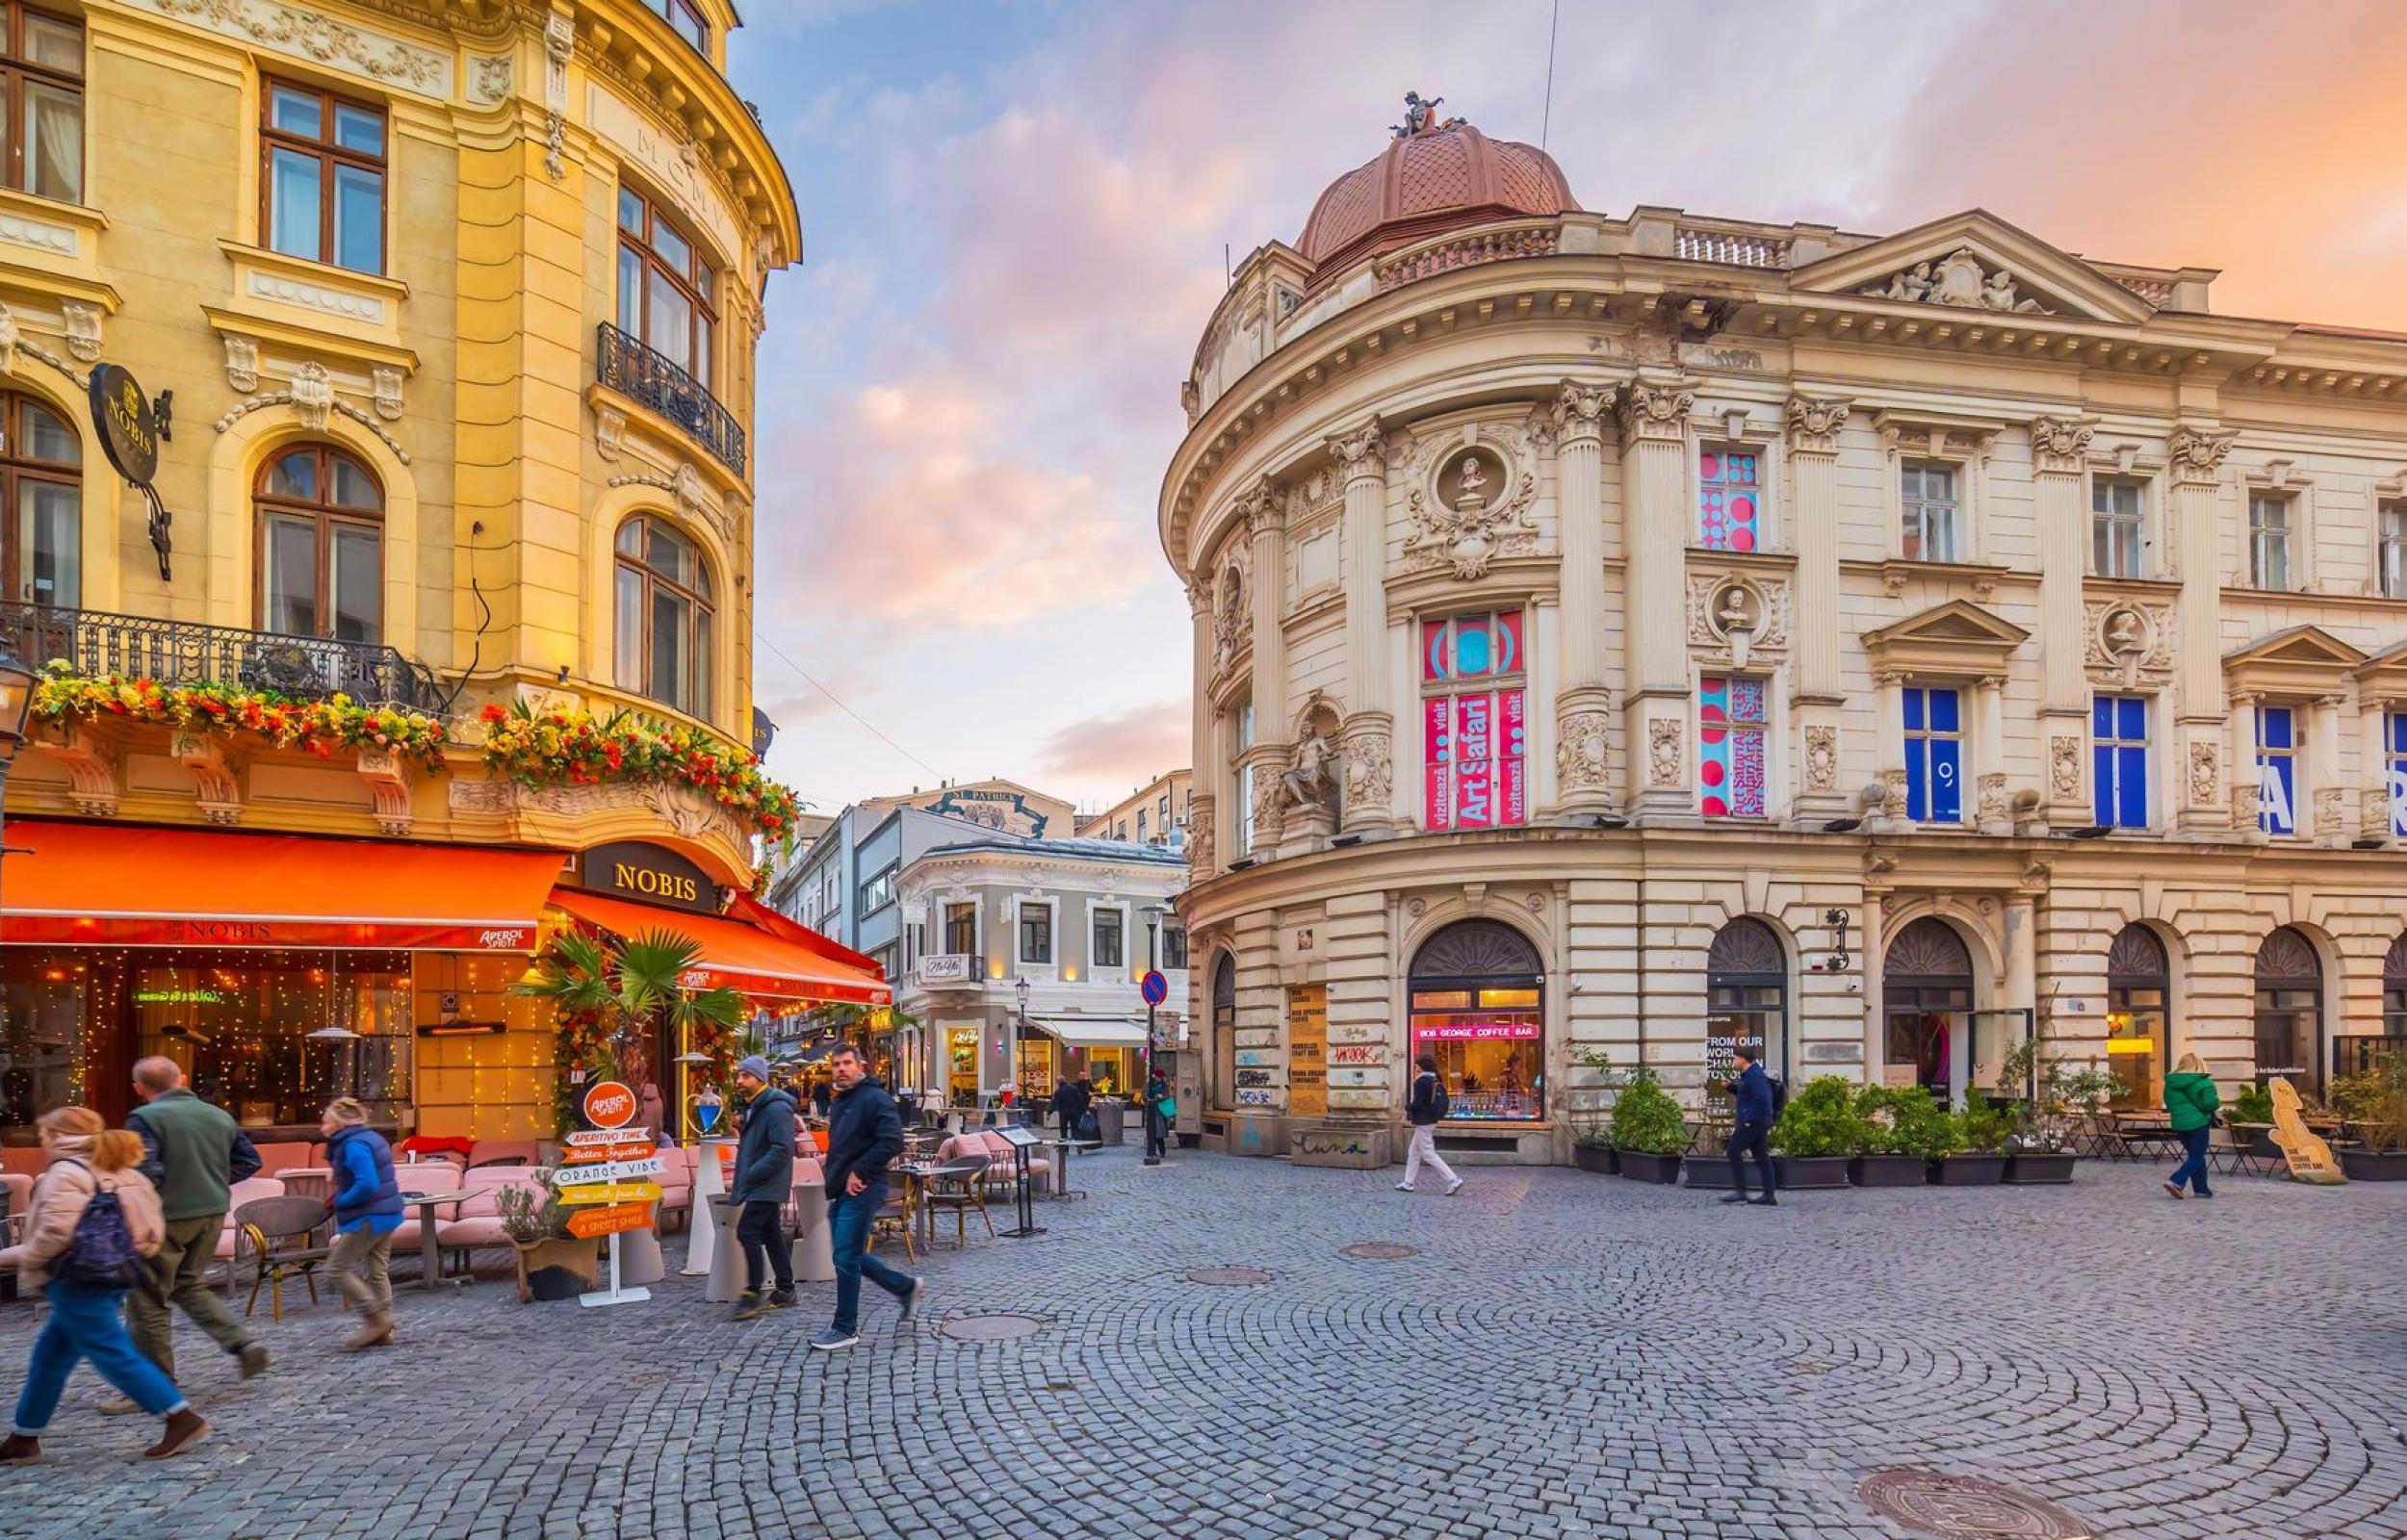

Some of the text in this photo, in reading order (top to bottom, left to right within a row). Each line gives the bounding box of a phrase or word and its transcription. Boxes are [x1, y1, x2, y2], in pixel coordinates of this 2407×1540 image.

[109, 395, 152, 456] NOBIS
[1434, 702, 1447, 825] vizitează visit
[1461, 700, 1488, 822] Art Safari
[1508, 693, 1522, 820] vizitează visit
[972, 792, 1016, 803] PATRICK
[614, 862, 697, 902] NOBIS
[190, 922, 271, 939] NOBIS
[479, 929, 524, 944] APEROL
[486, 938, 517, 949] SPRITZ
[1440, 1029, 1472, 1038] GEORGE
[1477, 1028, 1510, 1037] COFFEE
[1514, 1027, 1533, 1036] BAR
[1706, 1037, 1763, 1046] FROM OUR
[591, 1094, 629, 1112] APEROL
[598, 1106, 623, 1116] SPRITZ
[573, 1131, 642, 1143] APERITIVO TIME
[570, 1145, 649, 1159] Better Together
[627, 1161, 659, 1174] VIBE
[619, 1216, 643, 1228] SMILE
